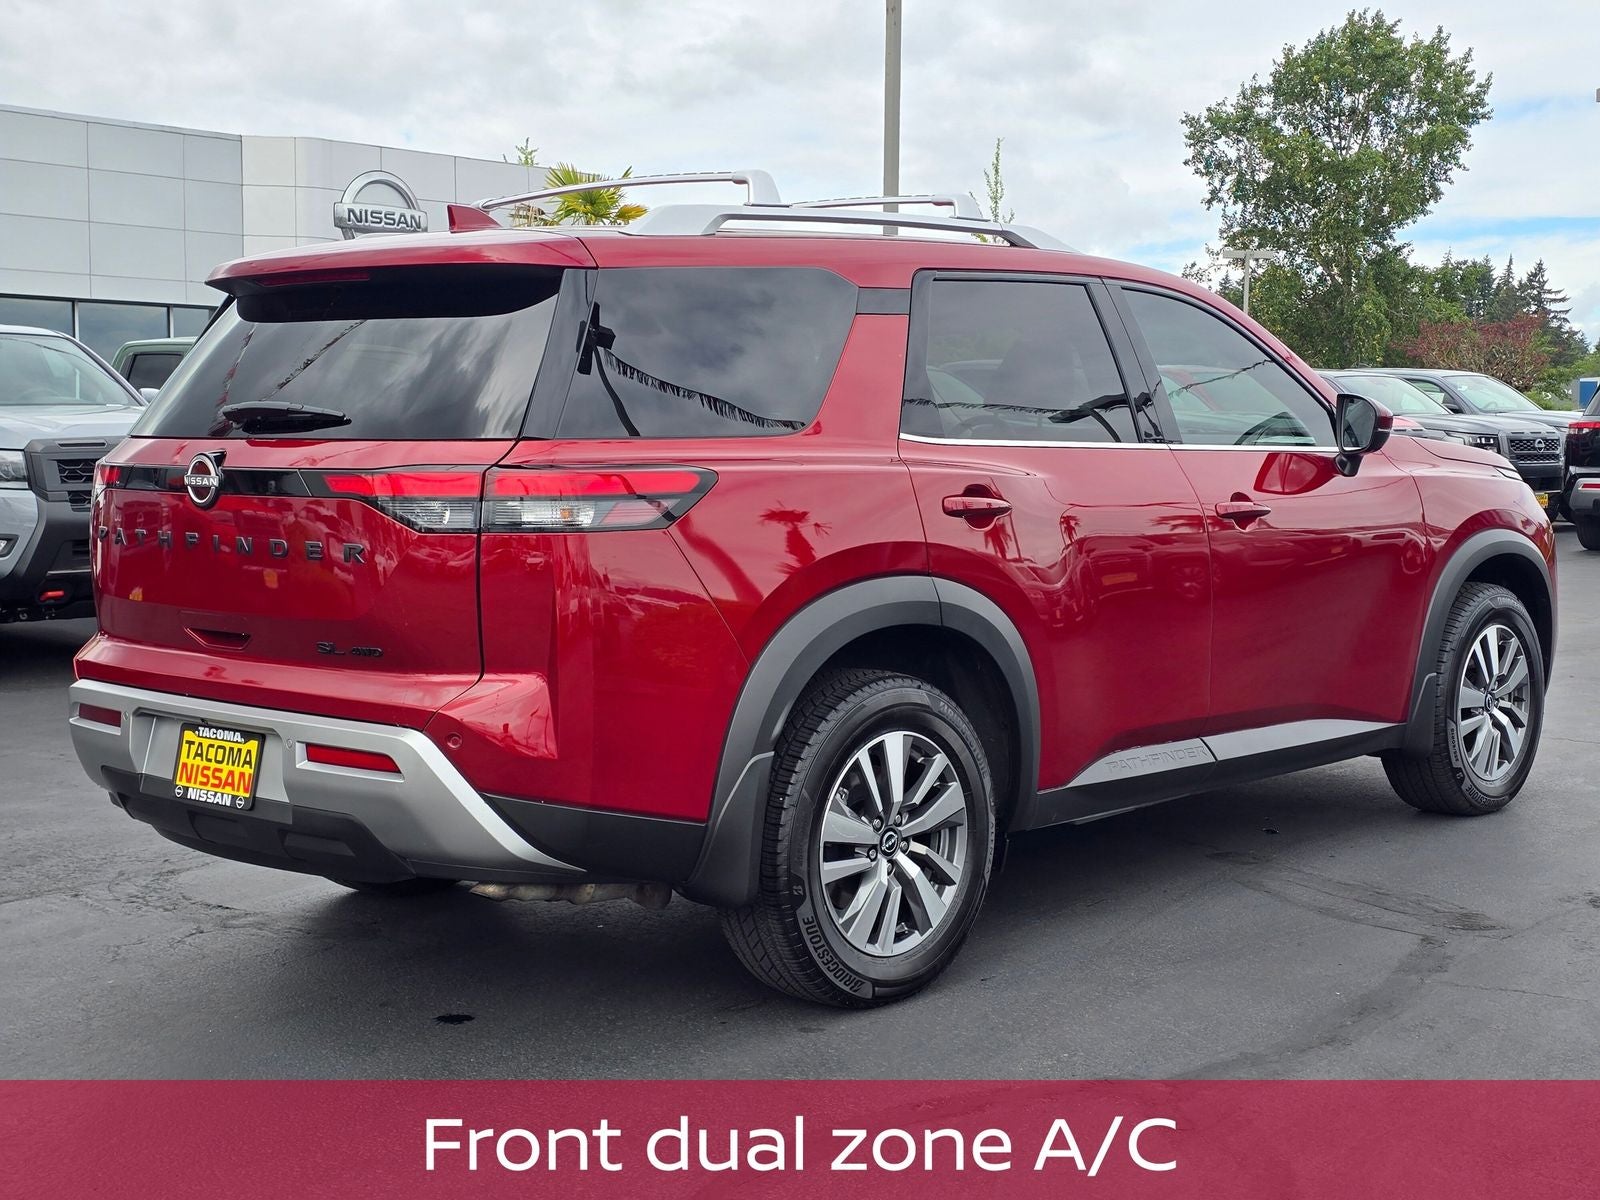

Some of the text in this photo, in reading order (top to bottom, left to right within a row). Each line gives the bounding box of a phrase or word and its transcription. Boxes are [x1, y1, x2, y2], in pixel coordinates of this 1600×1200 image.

[346, 207, 422, 230] NISSAN
[184, 475, 217, 486] NISSAN
[98, 525, 367, 564] PATHFINDER
[316, 641, 345, 656] SL
[198, 727, 241, 743] TACOMA
[184, 739, 253, 769] TACOMA
[1105, 745, 1208, 774] PATHFINDER
[178, 762, 252, 794] NISSAN
[187, 787, 232, 807] NISSAN
[802, 915, 866, 993] BRIDGESTONE
